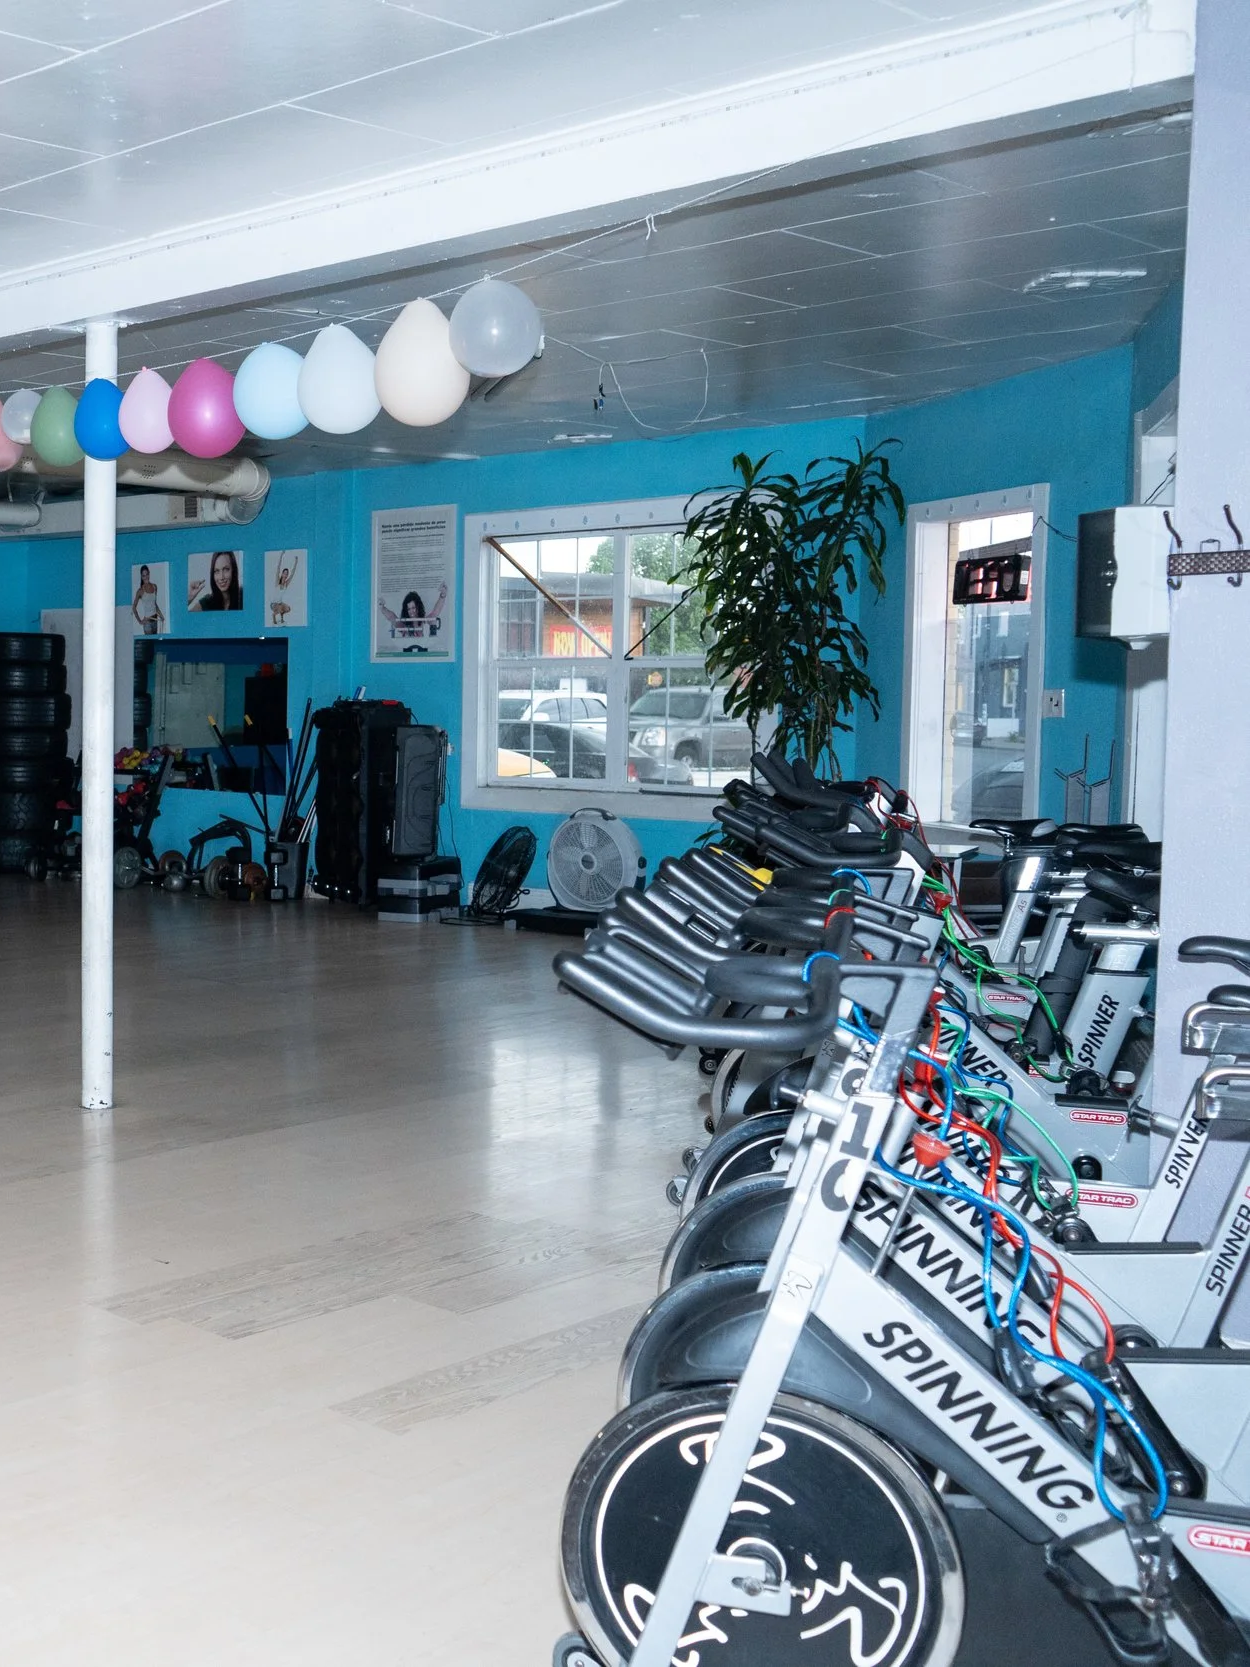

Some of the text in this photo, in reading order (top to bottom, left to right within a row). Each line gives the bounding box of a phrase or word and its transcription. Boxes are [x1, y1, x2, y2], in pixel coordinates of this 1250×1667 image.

[1077, 994, 1120, 1068] SPINNER
[1072, 1112, 1122, 1122] STAR TRAC
[1100, 1195, 1132, 1204] TRAC
[862, 1320, 1096, 1516] SPINNING
[1194, 1532, 1248, 1551] STAR
